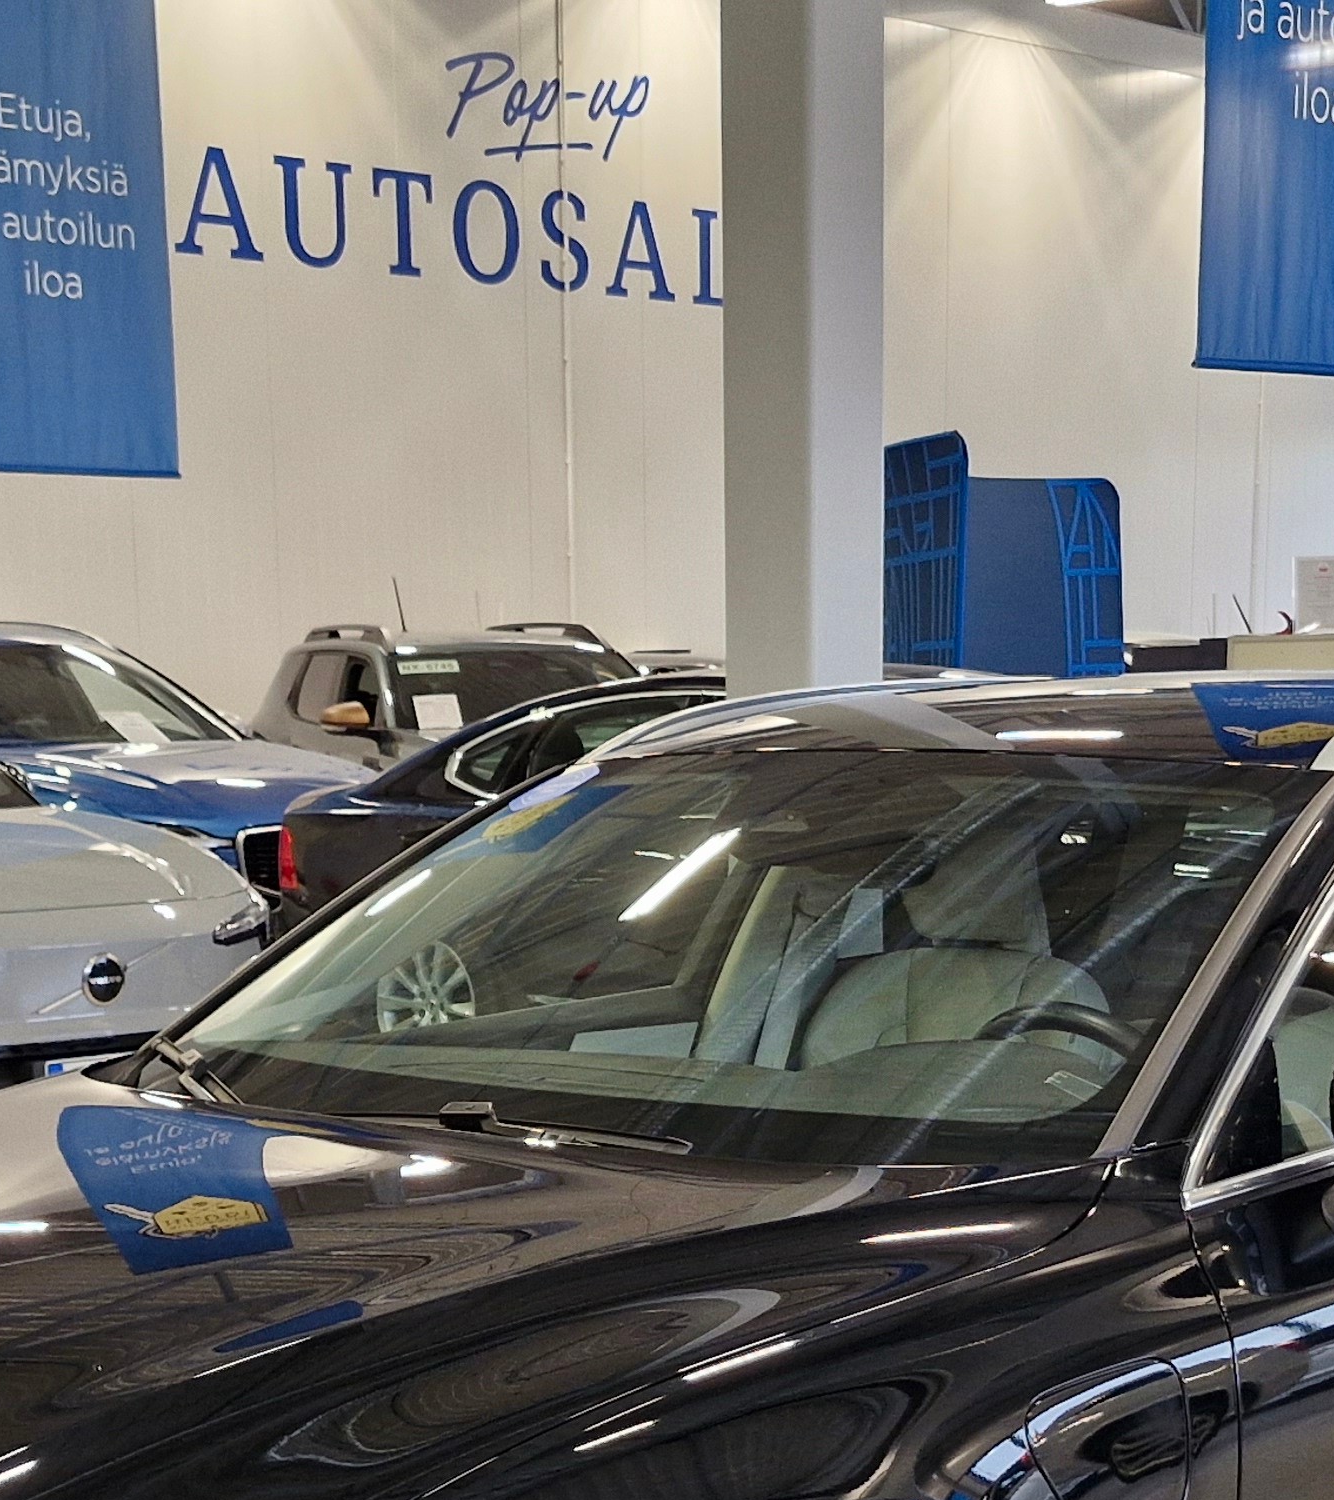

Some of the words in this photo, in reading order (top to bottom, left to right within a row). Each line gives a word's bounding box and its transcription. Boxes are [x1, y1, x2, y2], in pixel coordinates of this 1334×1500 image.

[445, 51, 650, 162] Pop-up
[2, 209, 135, 250] autoilun
[23, 260, 83, 300] iloa
